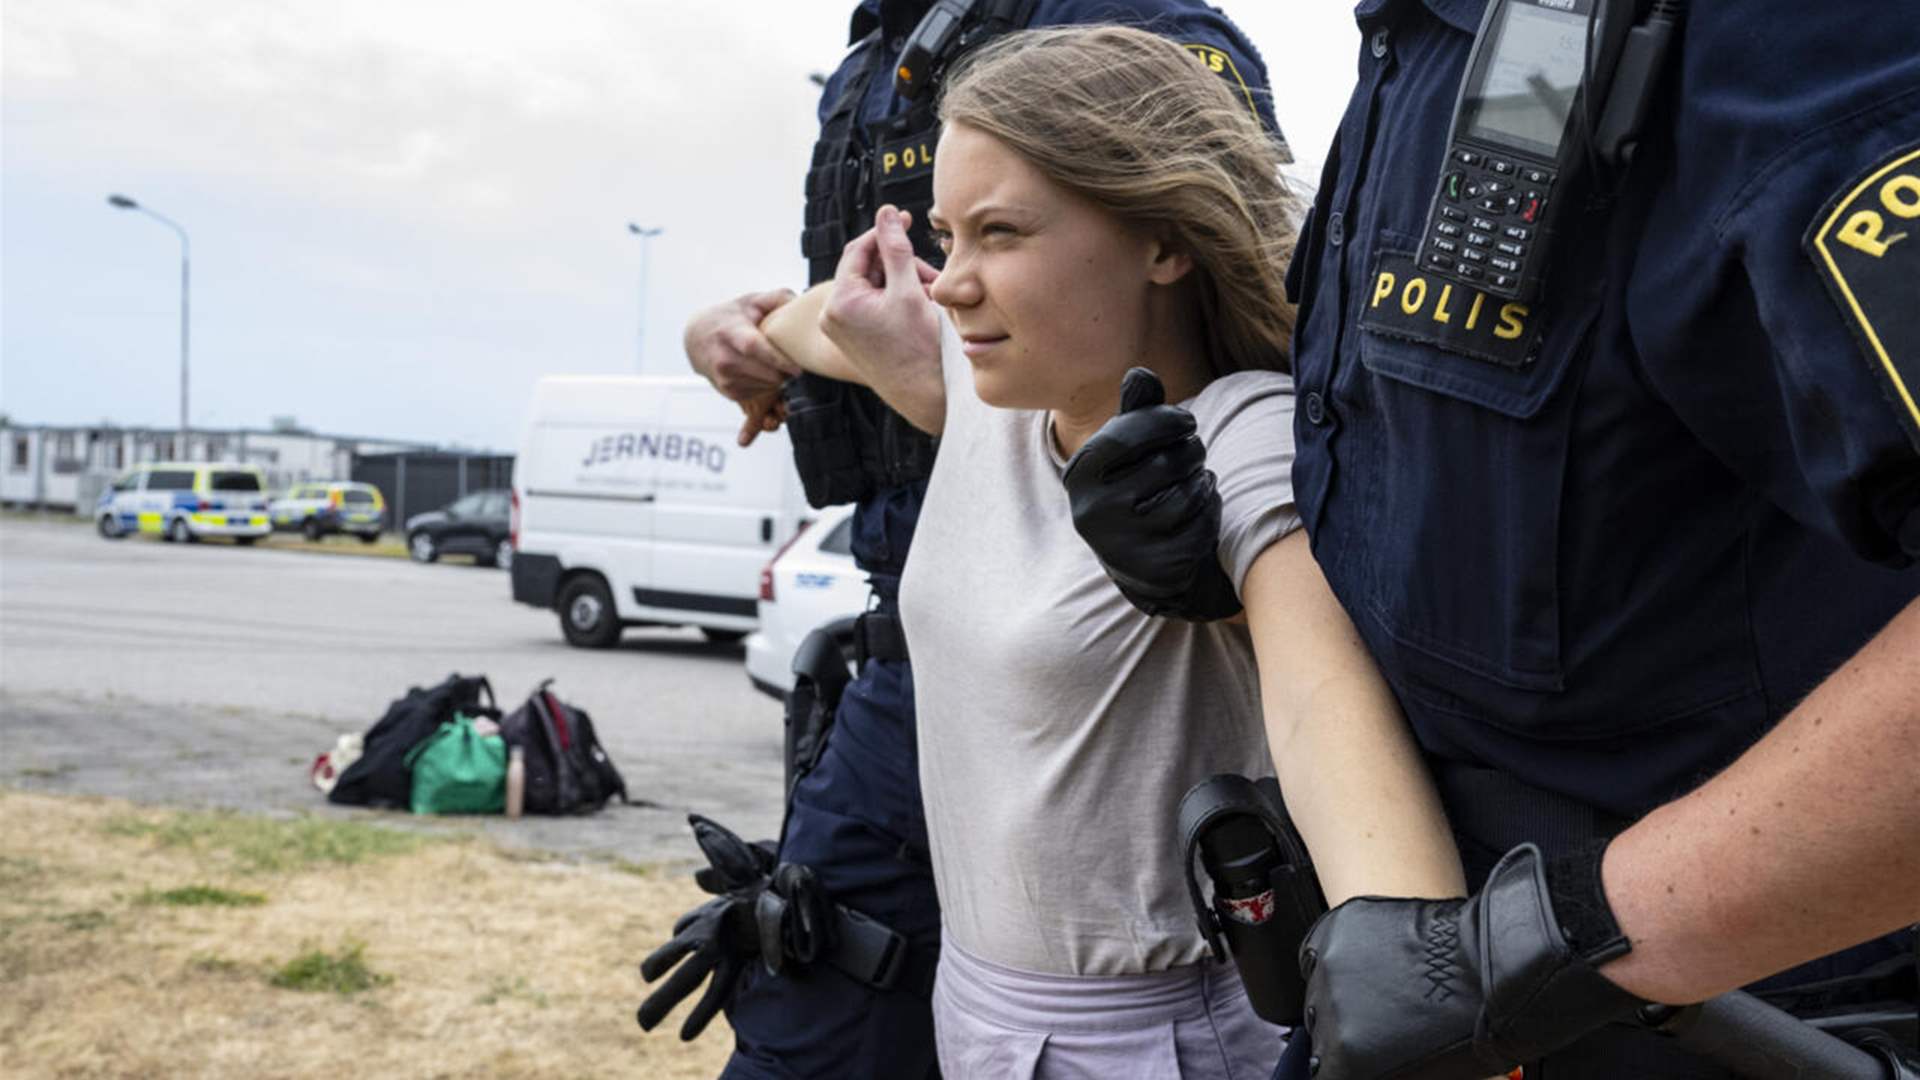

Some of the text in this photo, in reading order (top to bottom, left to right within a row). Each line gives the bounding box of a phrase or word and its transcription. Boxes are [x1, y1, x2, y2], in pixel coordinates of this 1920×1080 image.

[883, 144, 932, 175] POL
[1836, 174, 1920, 258] PO
[1370, 272, 1529, 339] POLIS
[582, 432, 727, 474] JERNBRO
